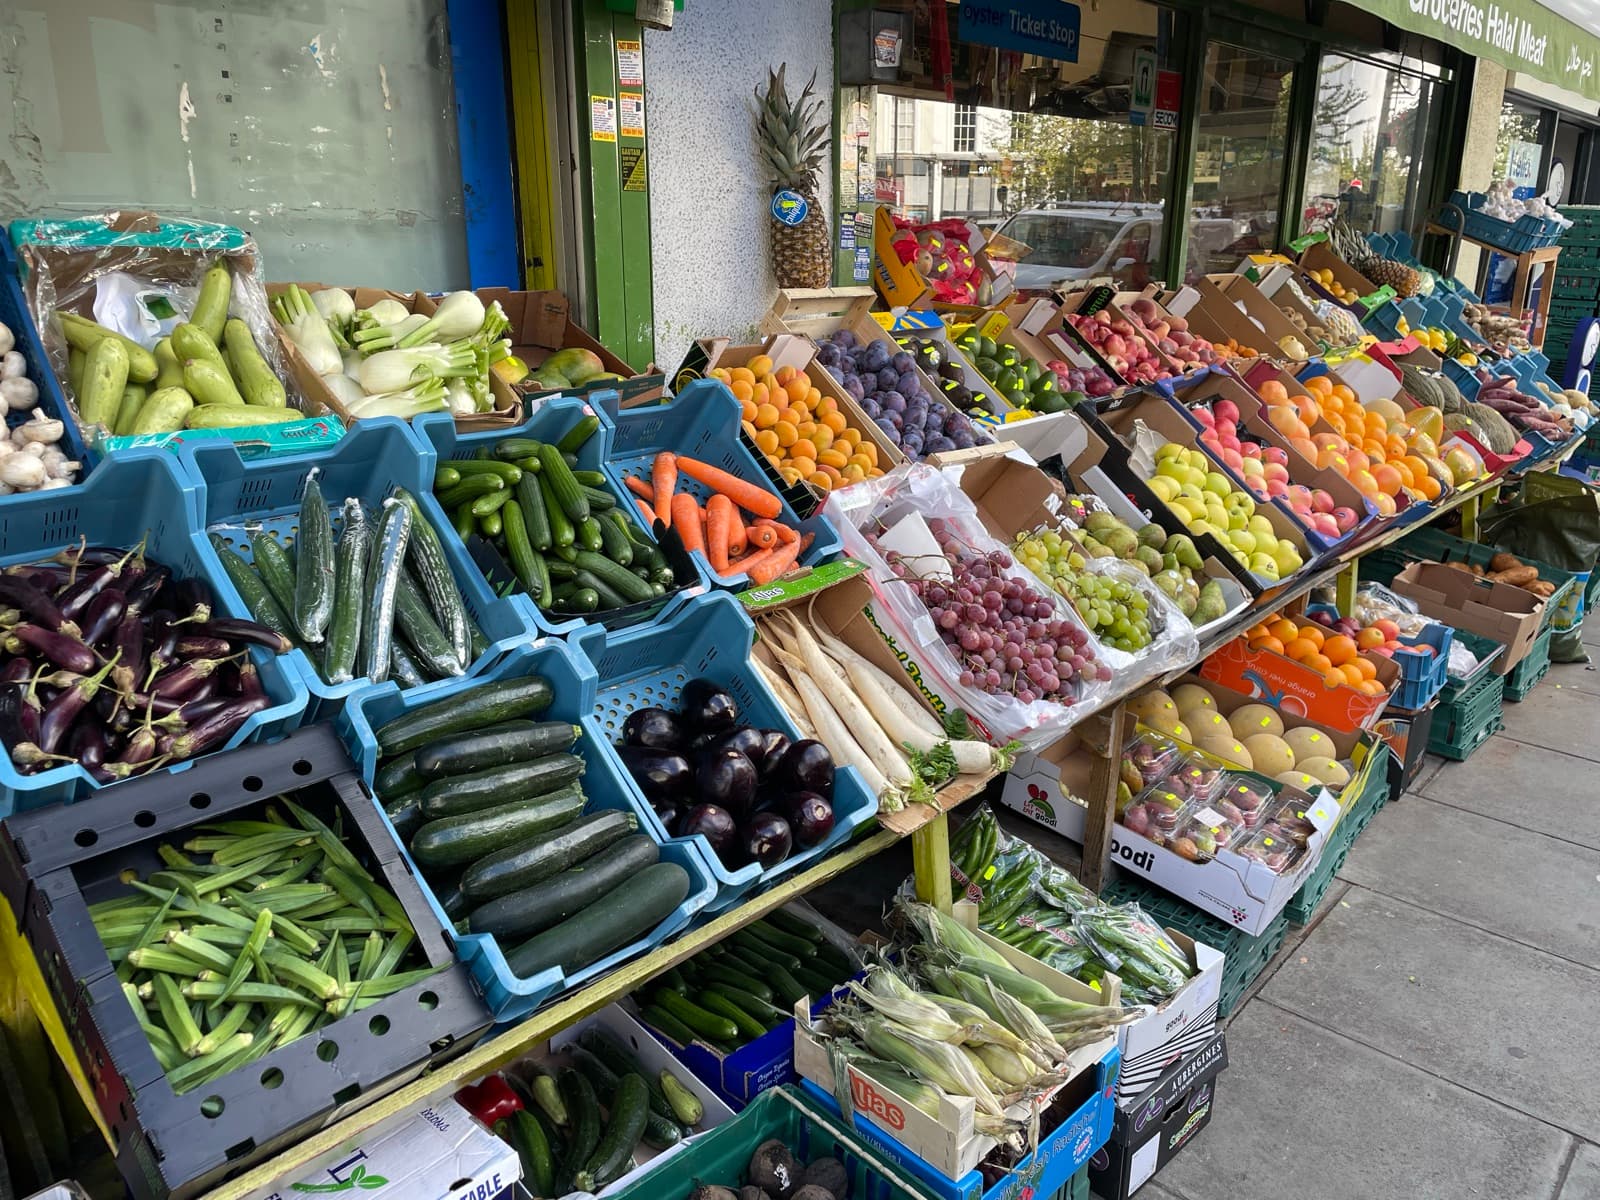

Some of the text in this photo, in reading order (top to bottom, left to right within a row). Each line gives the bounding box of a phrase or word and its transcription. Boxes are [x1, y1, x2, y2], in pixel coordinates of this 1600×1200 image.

[964, 6, 1076, 48] oyster Ticket Stop
[1485, 3, 1518, 54] Halal
[1518, 20, 1547, 67] Meat
[1155, 111, 1177, 126] SECOM
[785, 199, 805, 225] Chiquita
[1268, 673, 1286, 686] river
[1287, 681, 1316, 698] orange
[1036, 812, 1058, 828] goodi
[1172, 1041, 1222, 1092] AUBERGINES
